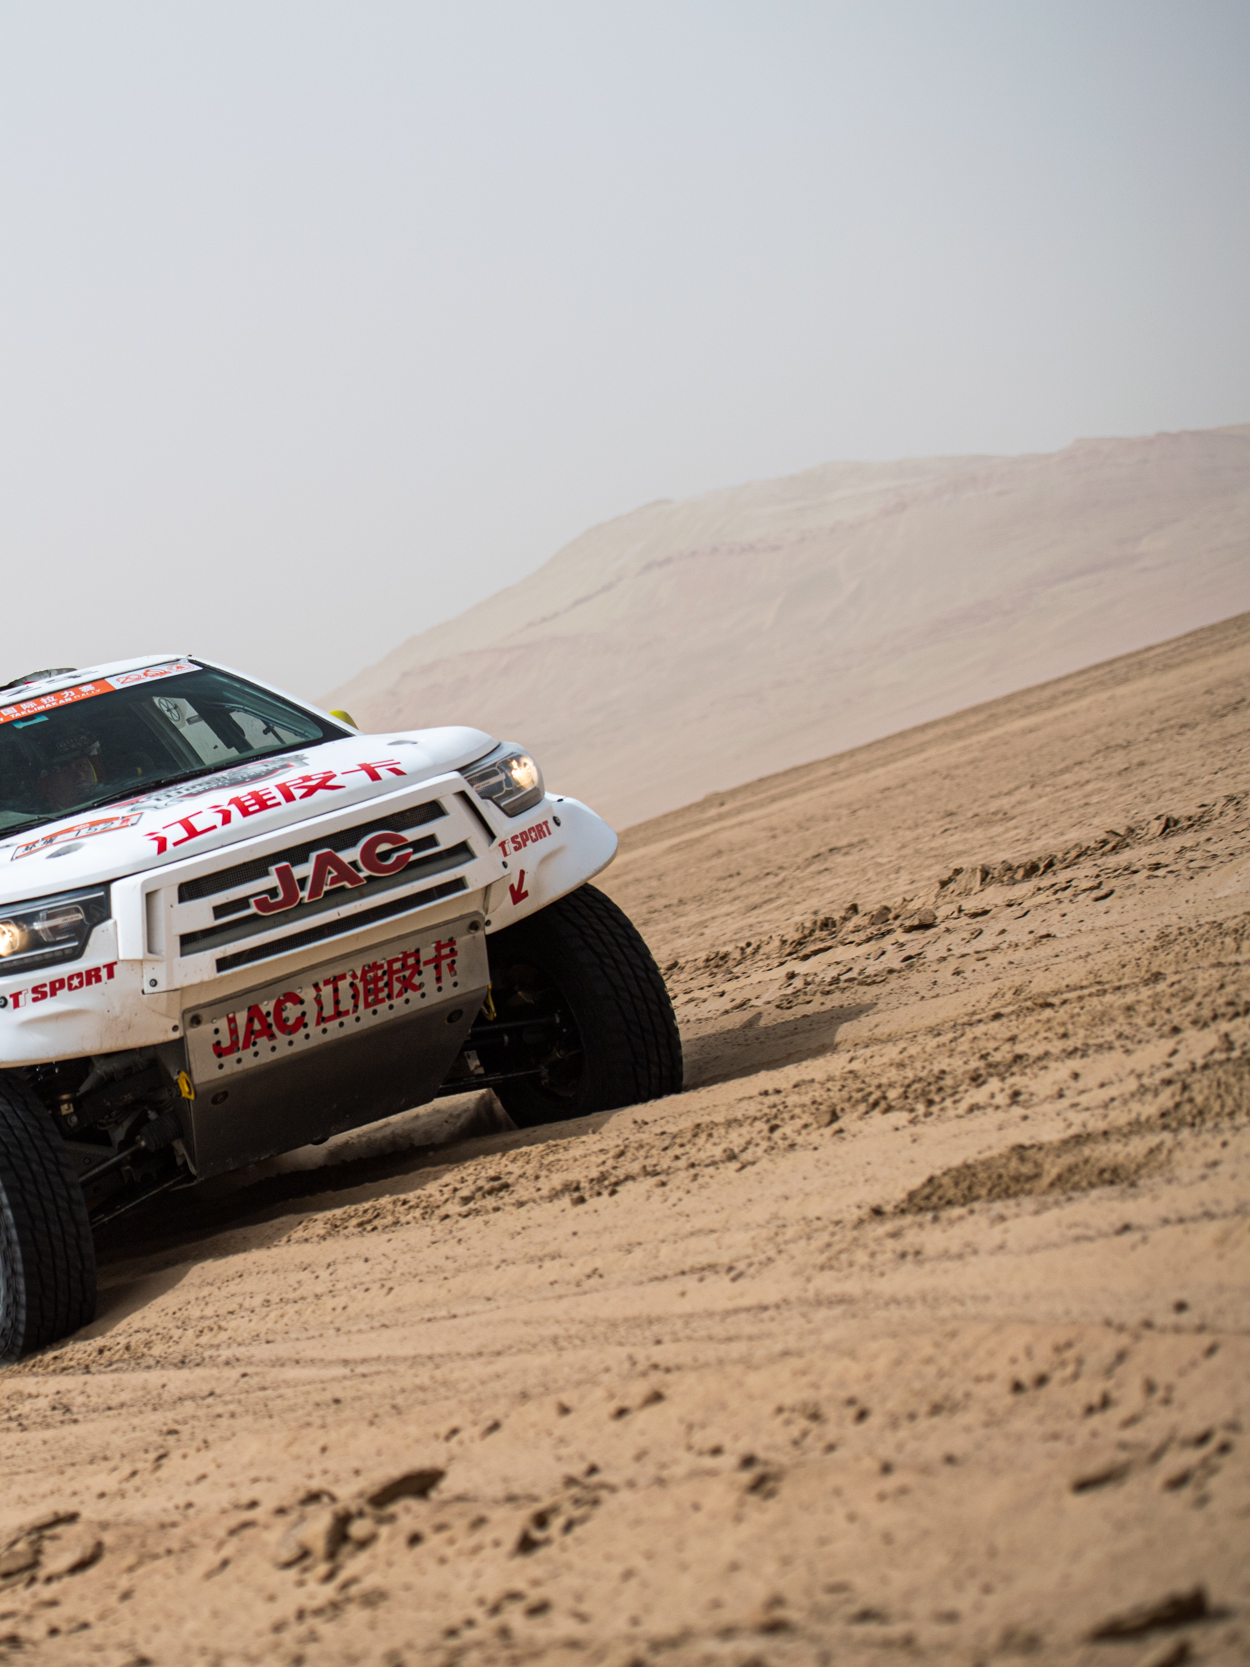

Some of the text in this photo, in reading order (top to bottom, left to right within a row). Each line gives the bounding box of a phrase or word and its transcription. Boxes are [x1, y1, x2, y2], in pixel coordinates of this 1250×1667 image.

[10, 697, 72, 719] TAKLIMAKAN
[73, 688, 101, 700] RALLY
[143, 759, 407, 856] 江淮皮卡
[510, 820, 552, 852] SPORT
[251, 831, 414, 916] JAC
[31, 961, 118, 1003] SPORT
[212, 939, 458, 1059] JAC 江淮皮卡
